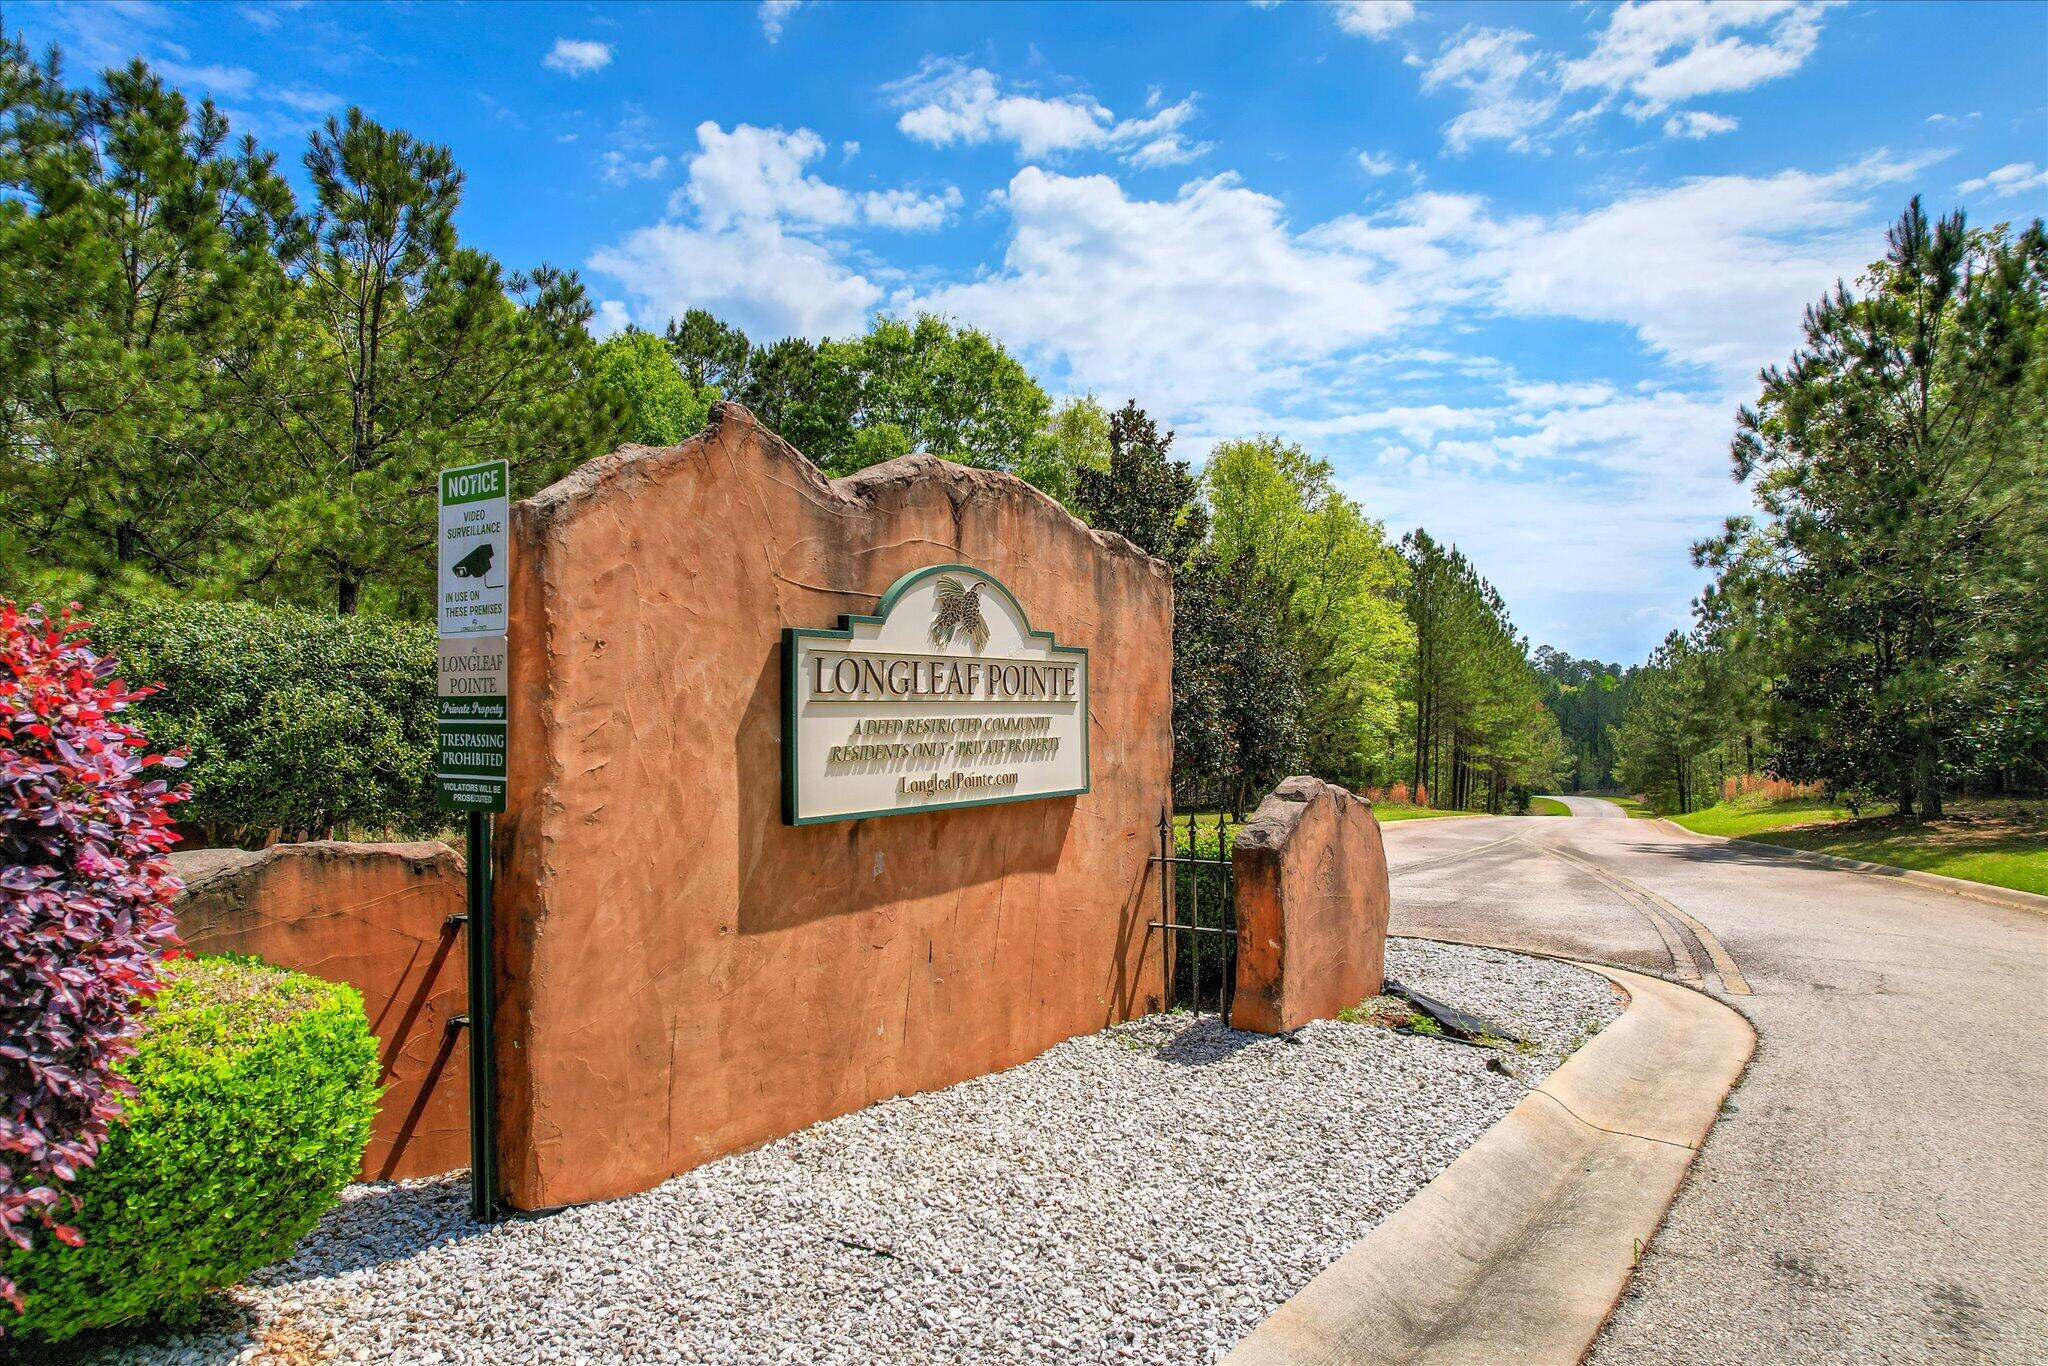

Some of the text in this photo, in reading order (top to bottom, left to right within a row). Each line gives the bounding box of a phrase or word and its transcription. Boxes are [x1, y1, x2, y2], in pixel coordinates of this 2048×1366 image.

[448, 469, 499, 498] NOTICE
[463, 509, 486, 522] VIDEO
[447, 521, 501, 540] SURVEILLANCE
[445, 590, 480, 603] IN USE ON
[445, 603, 503, 618] THESE PREMISES
[442, 654, 504, 672] LONGLEAF
[450, 677, 497, 694] POINTE
[813, 657, 1076, 697] LONGLEAF POINTE
[441, 701, 504, 718] Private Property
[852, 716, 1053, 736] A DEED RESTRICTED COMMUNITY
[441, 733, 504, 748] TRESPASSING
[831, 736, 1062, 762] RESIDENTS ONLY PRIVATE PROPERTY
[442, 751, 504, 767] PROHIBITED
[443, 782, 502, 794] VIOLATORS WILL BE
[900, 770, 1019, 798] LongleafPointe.com
[453, 793, 493, 804] PROSECUTED
